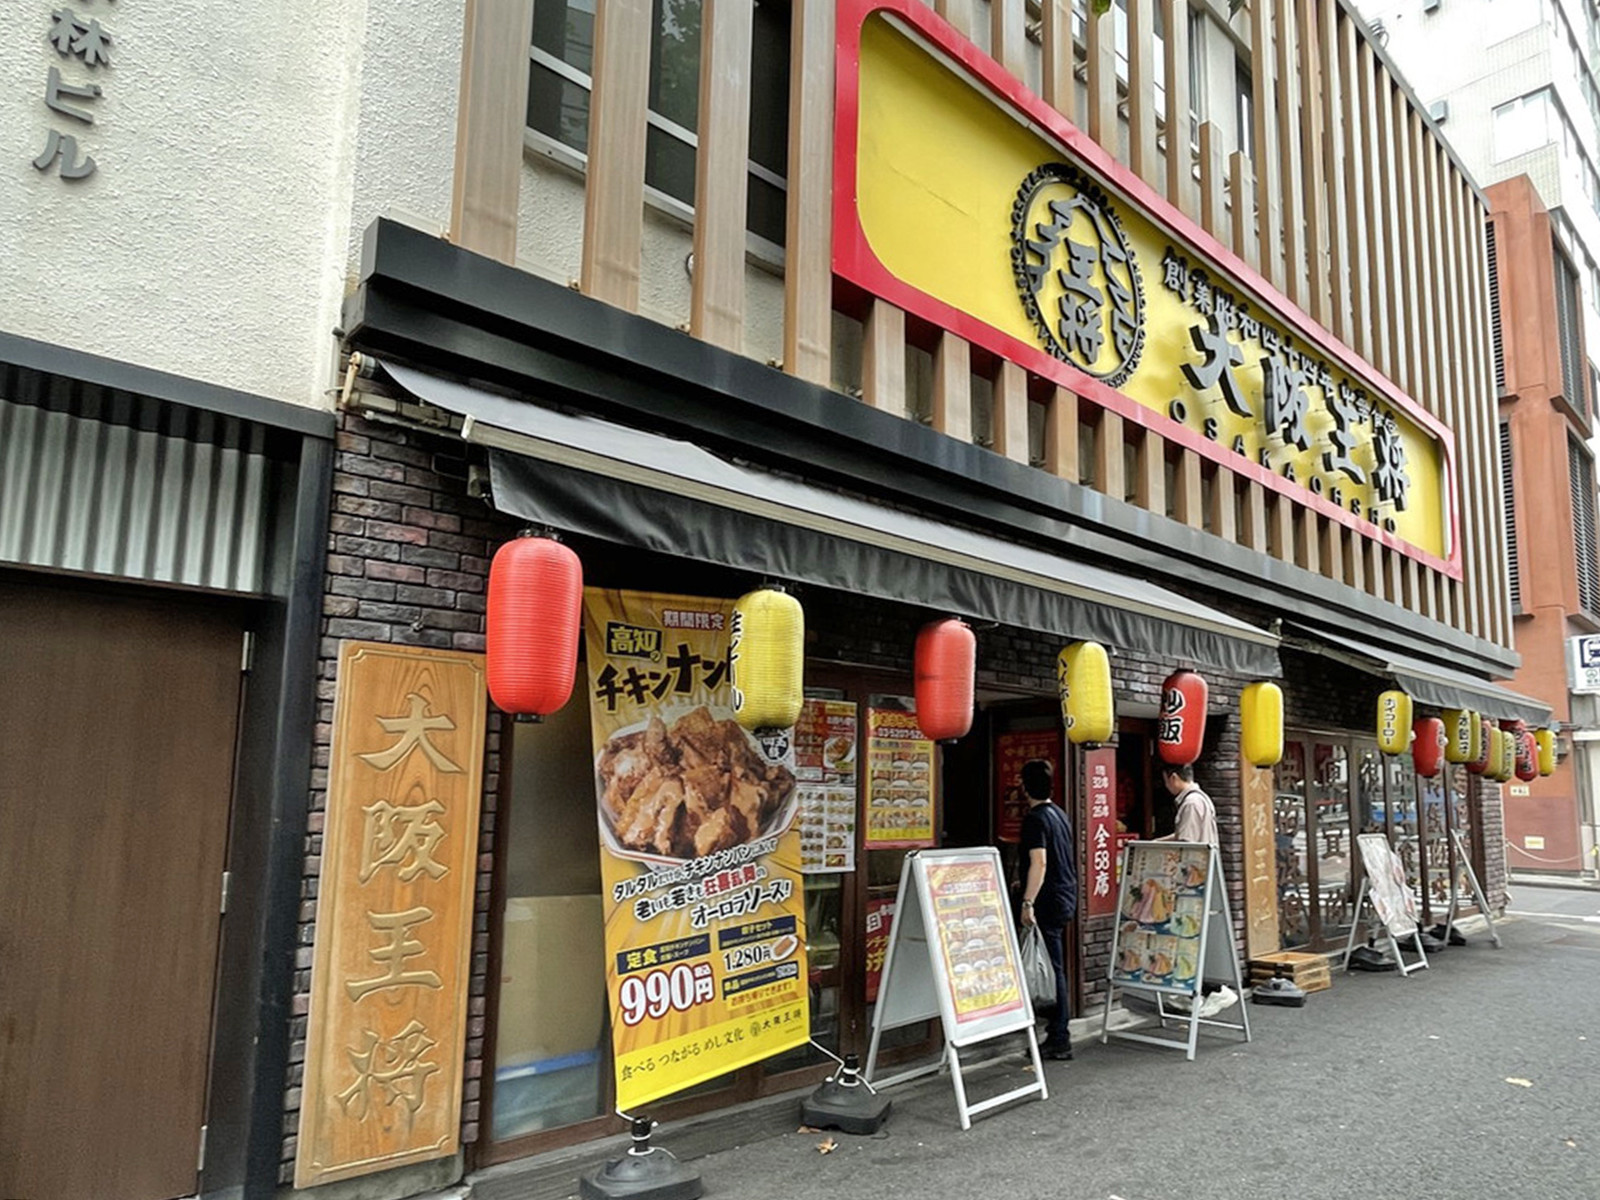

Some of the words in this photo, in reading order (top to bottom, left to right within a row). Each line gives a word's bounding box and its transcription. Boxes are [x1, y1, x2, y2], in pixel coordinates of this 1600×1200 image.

[32, 0, 118, 180] 林ビル
[1181, 314, 1410, 512] 大阪王将
[662, 609, 725, 630] 期間限定
[596, 643, 734, 713] チキンナン
[1093, 823, 1110, 897] 全58席
[333, 692, 466, 1122] 大阪王将
[626, 947, 658, 970] 定食
[621, 1057, 656, 1081] 食べる
[658, 1043, 701, 1063] つながる
[703, 1028, 745, 1051] めし文化
